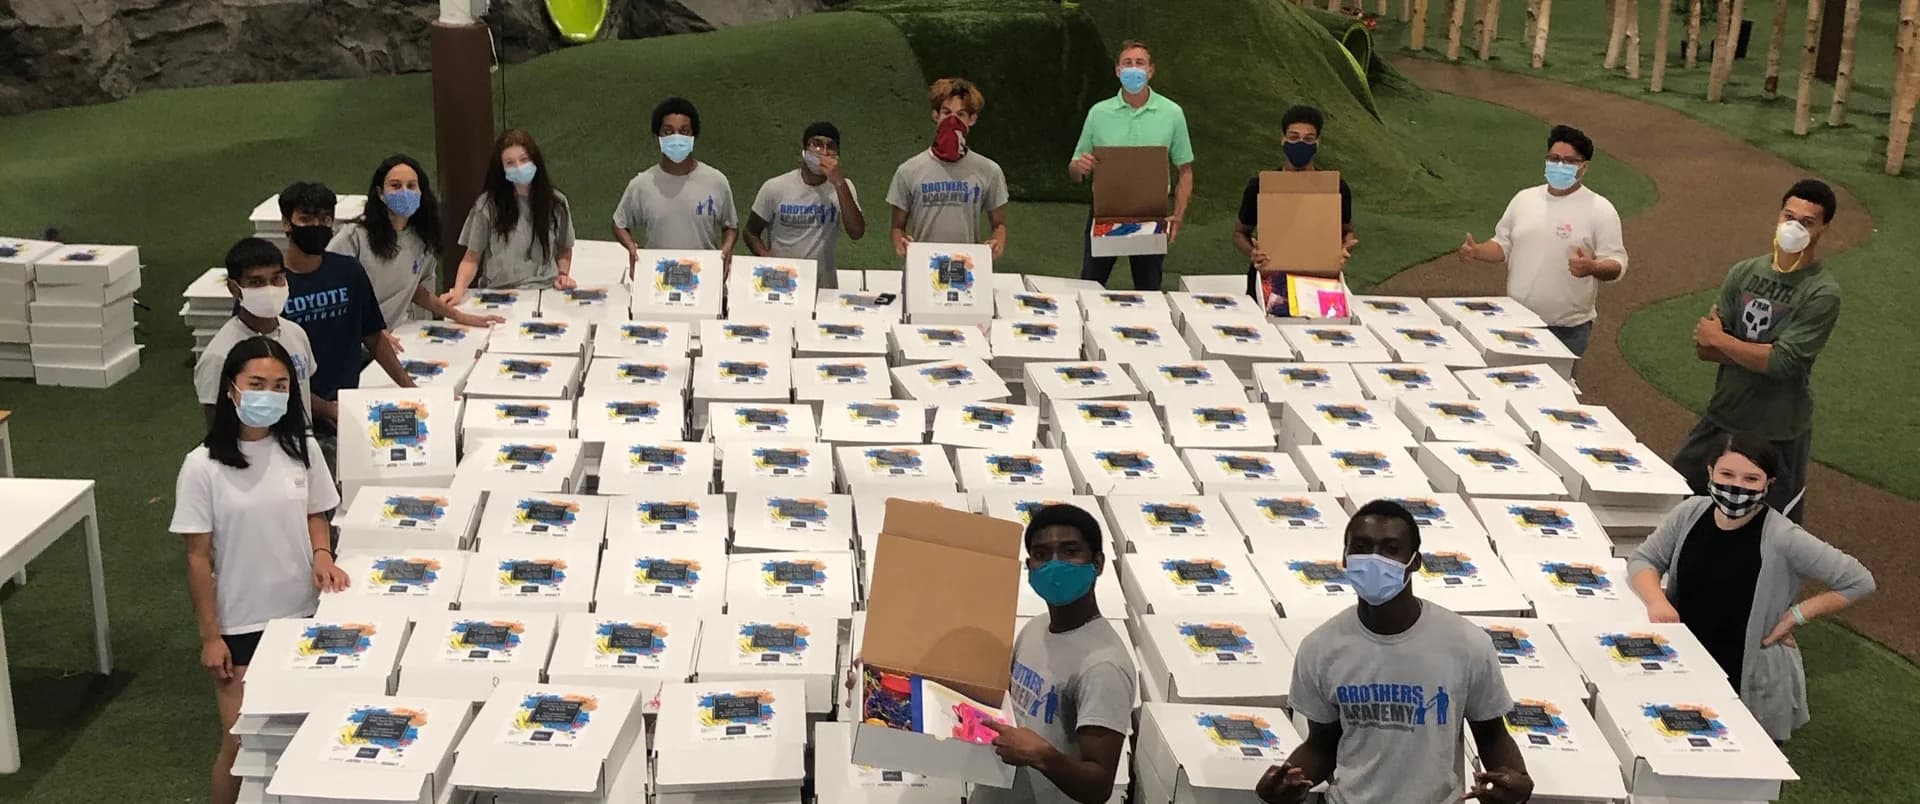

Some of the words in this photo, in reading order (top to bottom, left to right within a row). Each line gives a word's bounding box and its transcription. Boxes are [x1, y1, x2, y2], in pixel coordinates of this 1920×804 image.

[921, 181, 968, 193] BROTHERS
[780, 204, 824, 214] BROTHERS
[1744, 274, 1796, 304] DEATH
[284, 287, 349, 314] COYOTE
[1336, 683, 1424, 704] BROTHERS
[1341, 703, 1415, 725] ACADEMY
